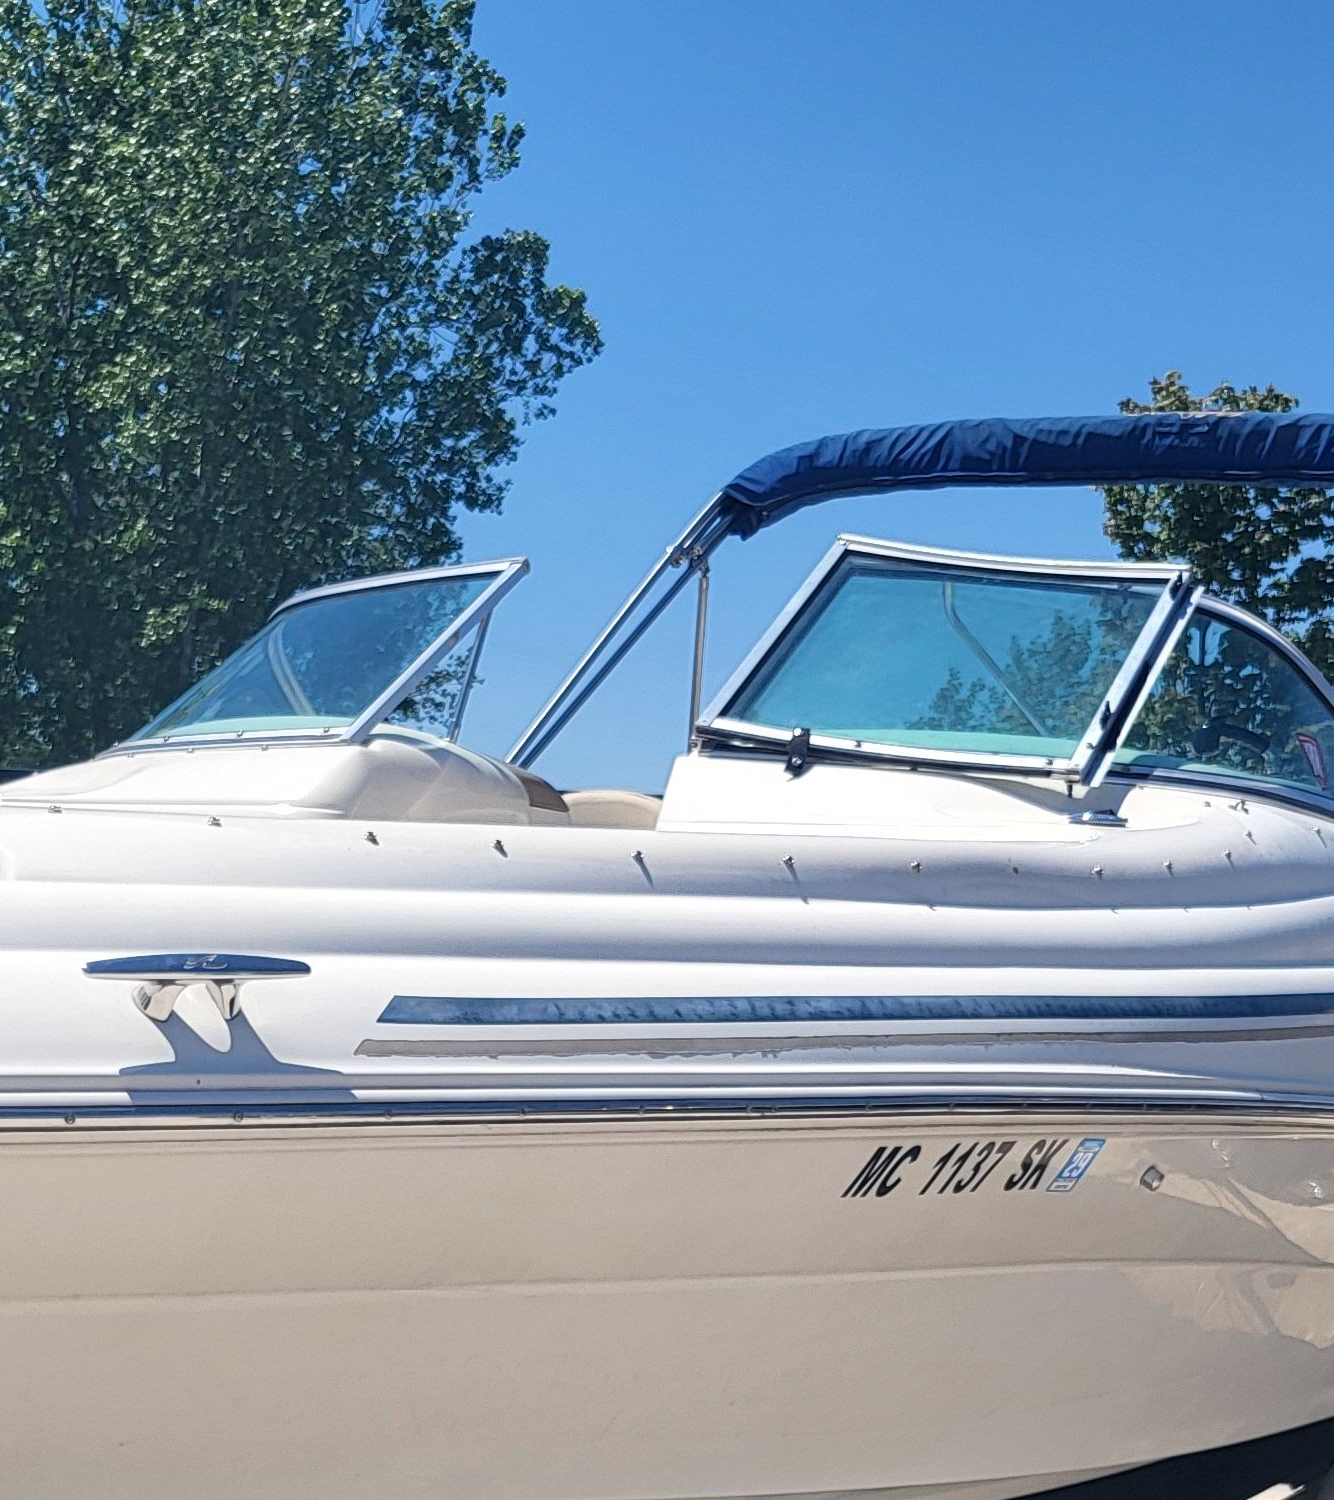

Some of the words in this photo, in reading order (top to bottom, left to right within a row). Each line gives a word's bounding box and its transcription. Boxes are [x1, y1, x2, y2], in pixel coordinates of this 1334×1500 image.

[839, 1144, 923, 1199] MC
[918, 1140, 1018, 1197] 1137
[1002, 1137, 1071, 1193] SK
[1060, 1151, 1095, 1178] 29
